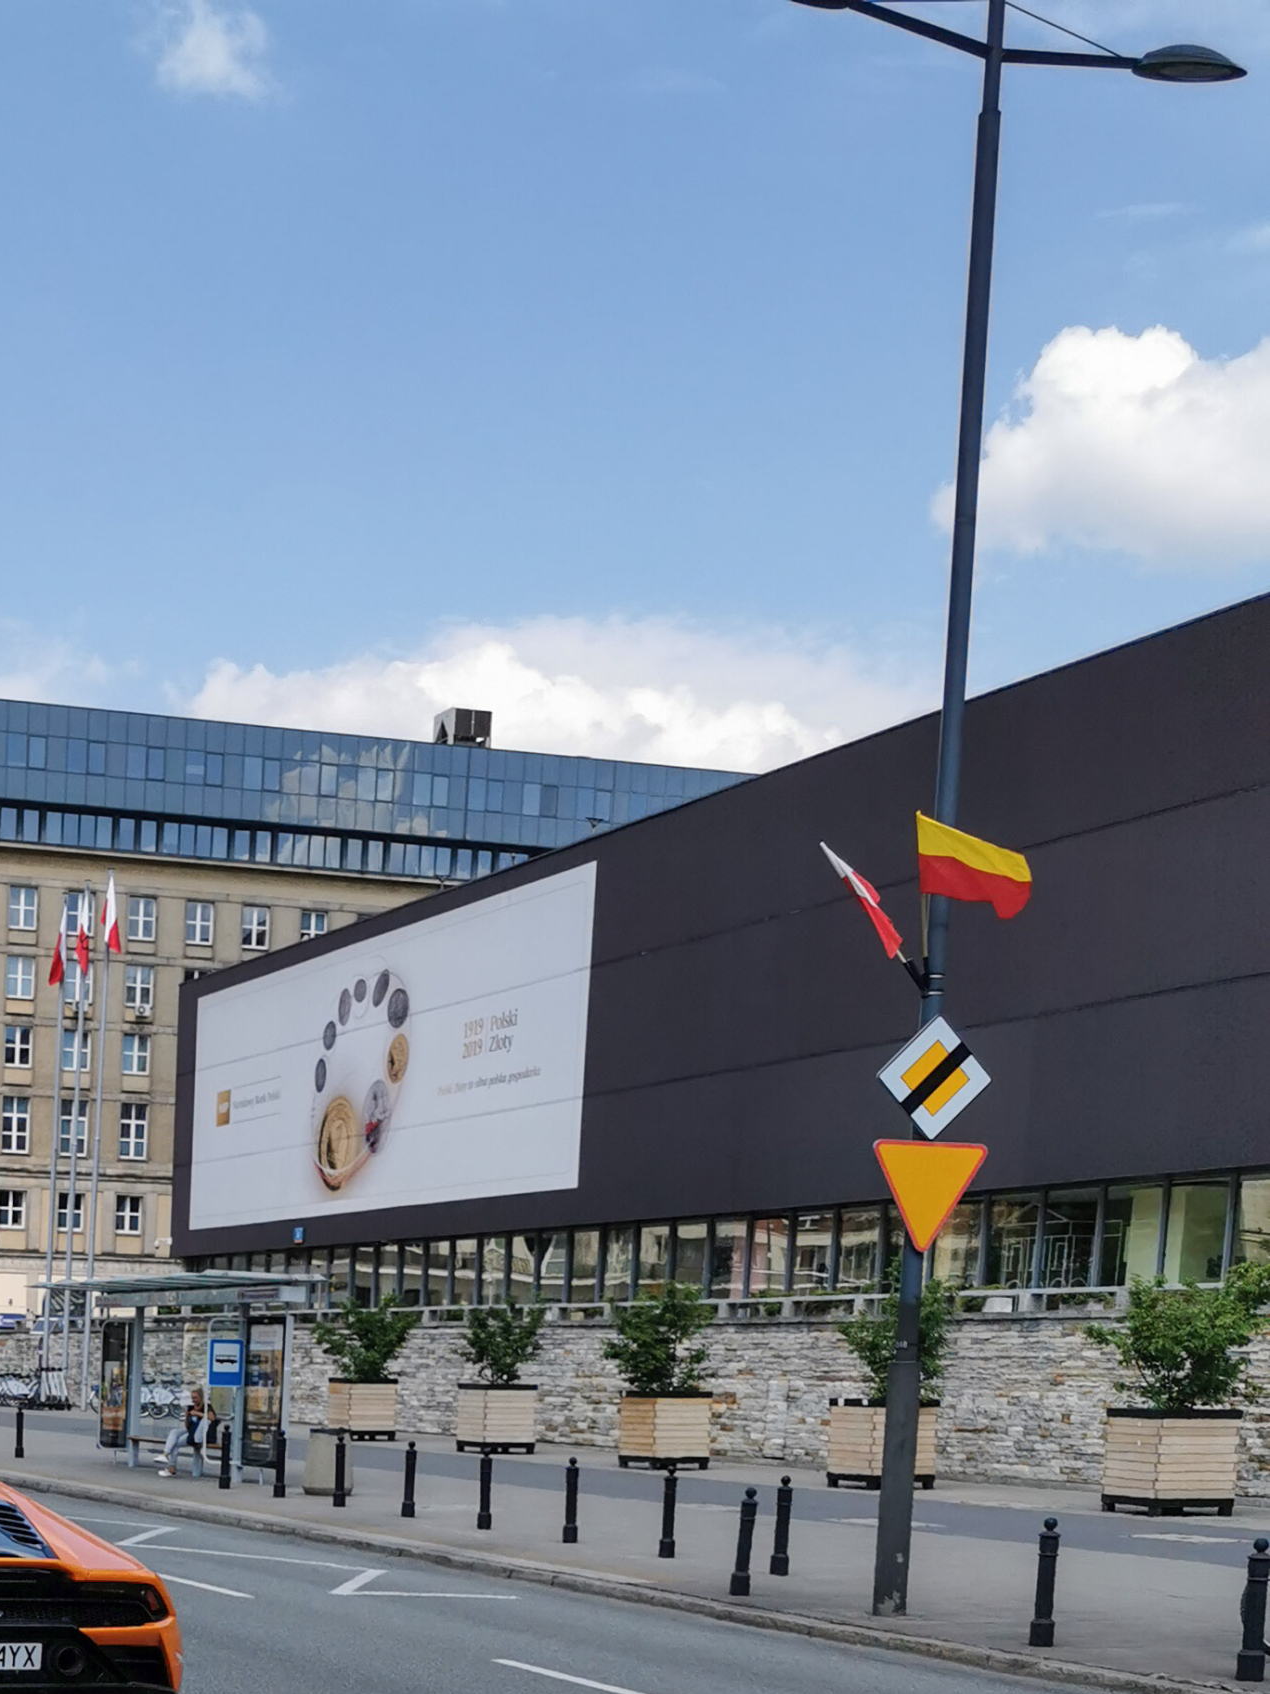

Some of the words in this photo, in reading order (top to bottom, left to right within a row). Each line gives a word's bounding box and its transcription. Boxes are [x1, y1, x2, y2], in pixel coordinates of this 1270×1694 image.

[463, 1017, 484, 1038] 1919
[490, 1008, 518, 1031] Polski
[462, 1038, 484, 1059] 2019
